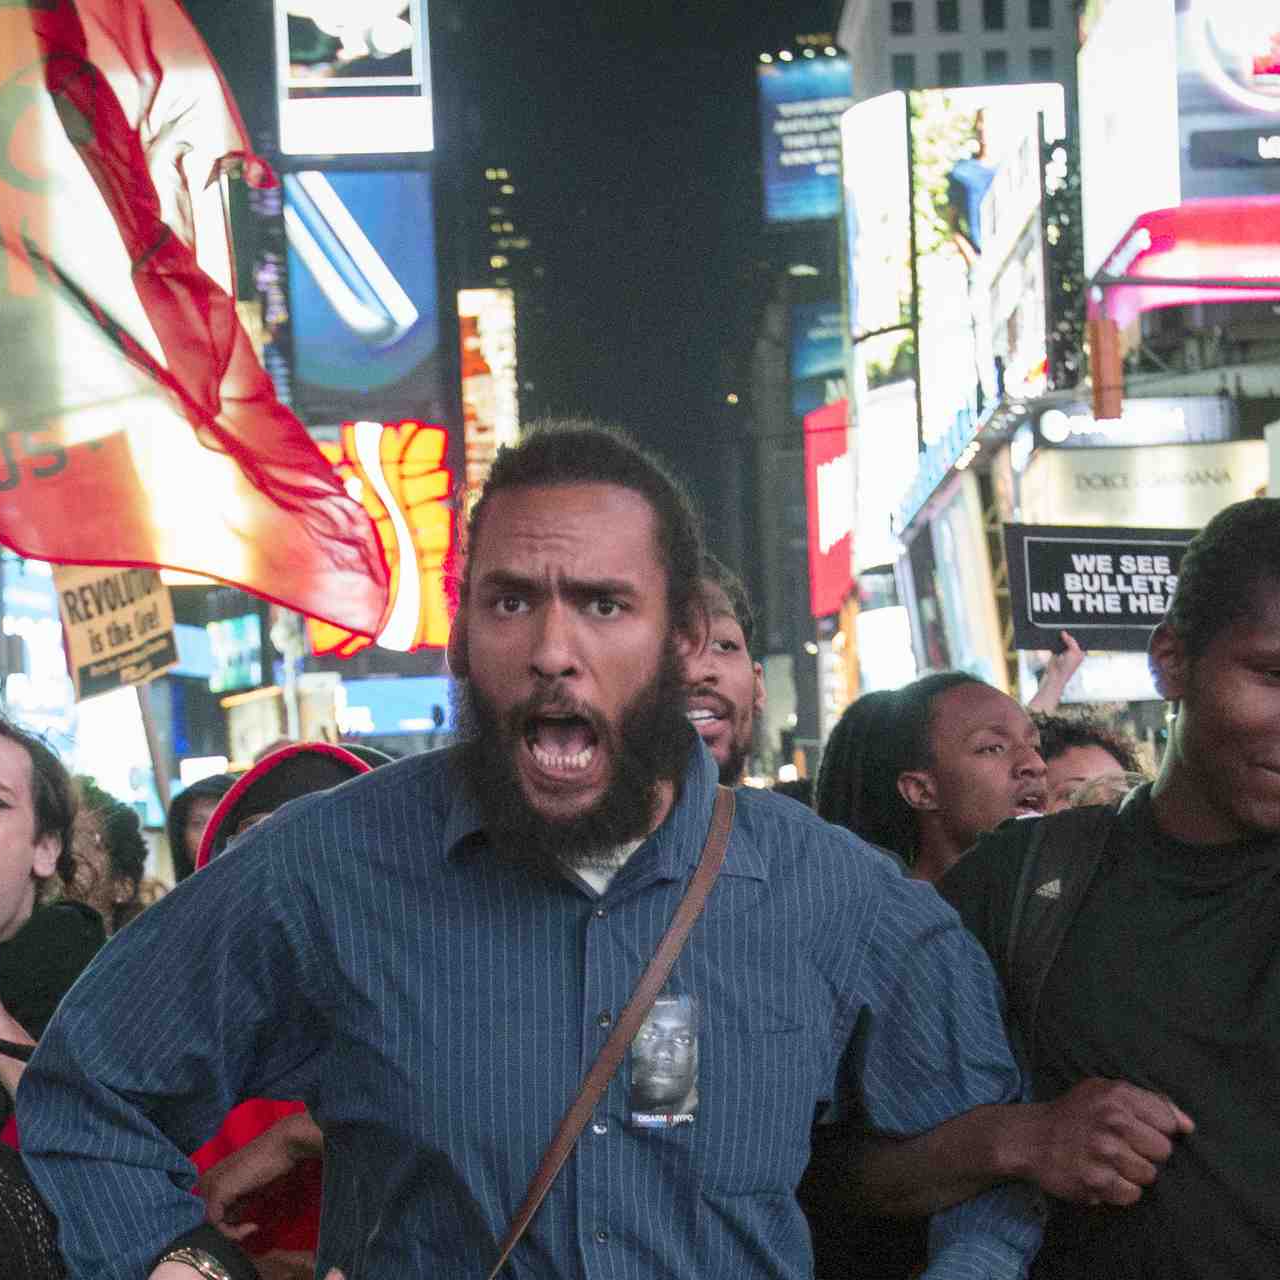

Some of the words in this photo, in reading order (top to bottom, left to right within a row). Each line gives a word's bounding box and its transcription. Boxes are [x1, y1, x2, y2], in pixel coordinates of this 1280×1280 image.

[1072, 554, 1113, 574] WE
[1120, 555, 1170, 574] SEE
[1064, 574, 1179, 593] BULLETS
[1032, 592, 1061, 612] IN
[1067, 593, 1122, 613] THE
[89, 628, 103, 654] is
